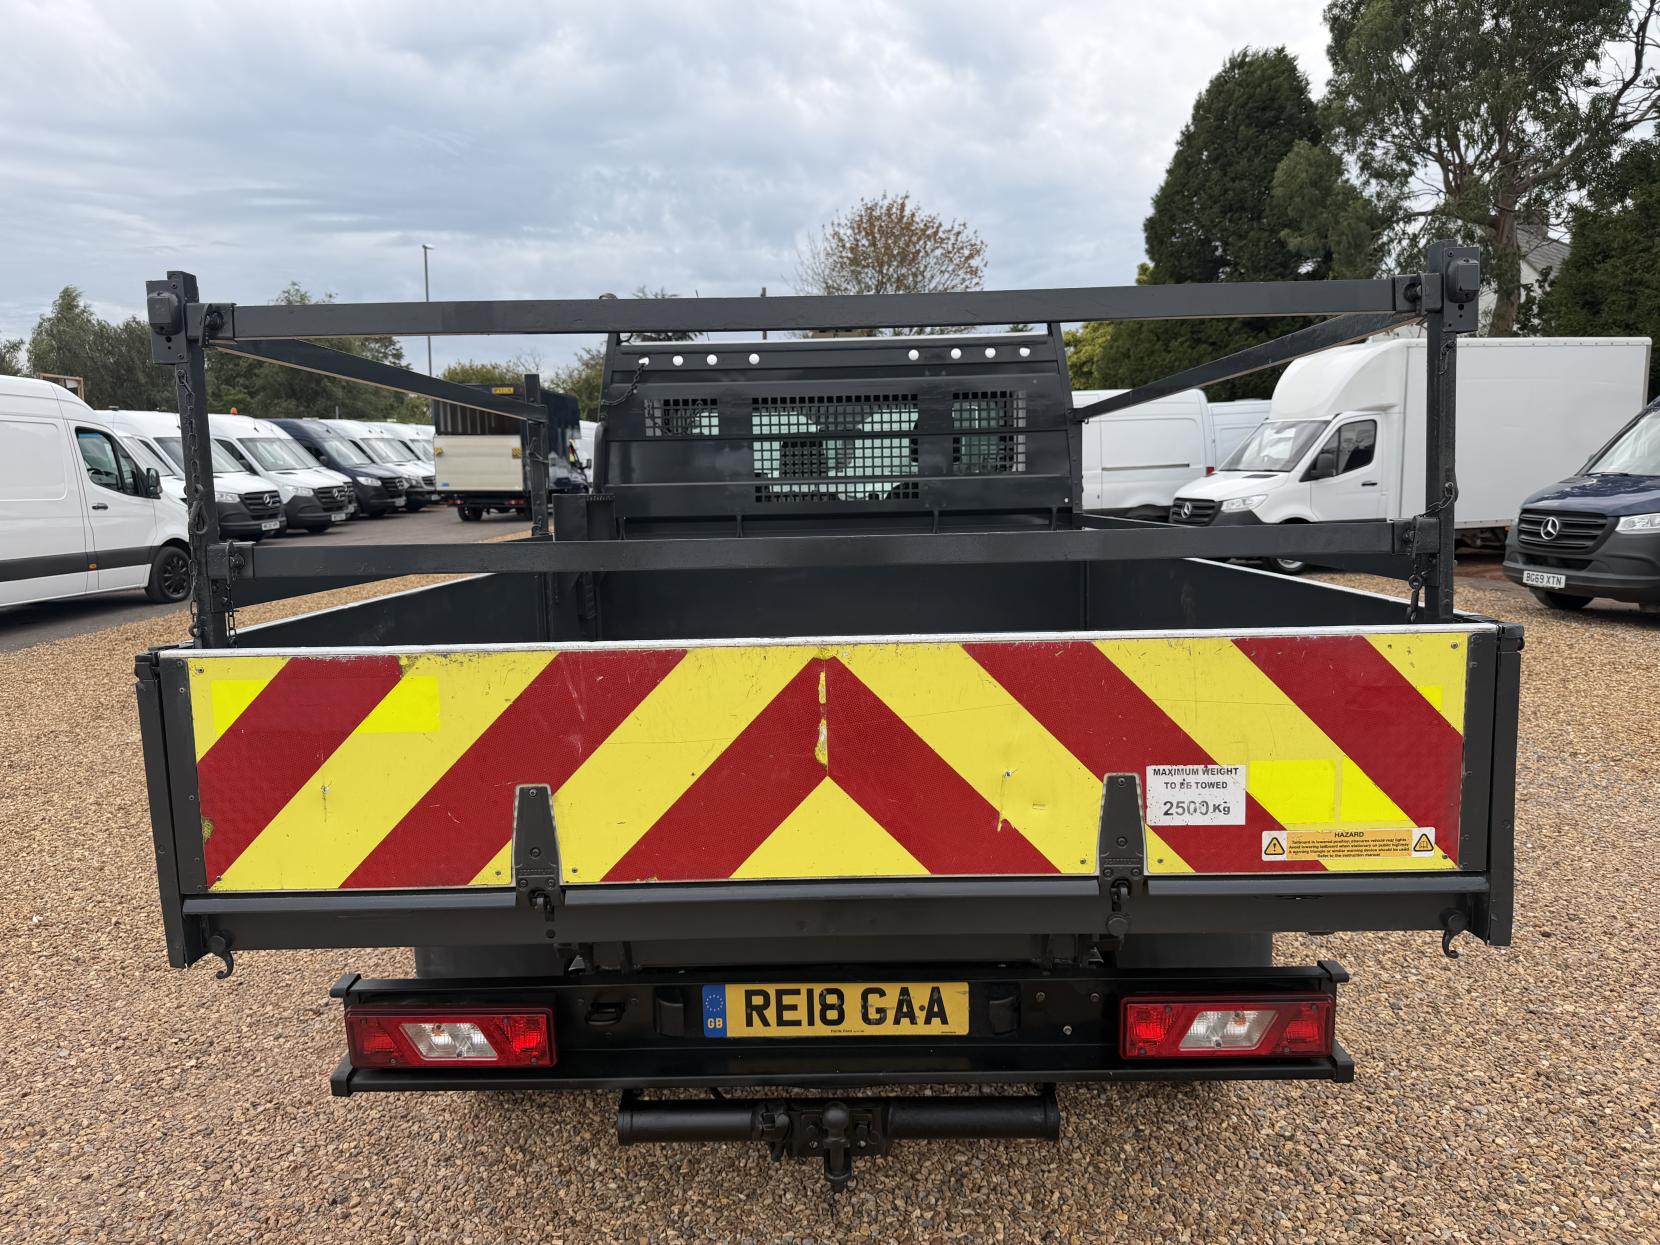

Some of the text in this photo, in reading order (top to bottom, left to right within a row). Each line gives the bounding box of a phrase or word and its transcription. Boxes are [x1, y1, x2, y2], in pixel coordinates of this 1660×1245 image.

[1526, 573, 1562, 585] BG69 XTN
[1153, 767, 1239, 776] MAXIMUM WEIGHT
[1164, 781, 1228, 790] TO BE TOWED
[1163, 800, 1209, 816] 2500
[744, 986, 949, 1028] RE18 GAA
[707, 1017, 723, 1029] GB
